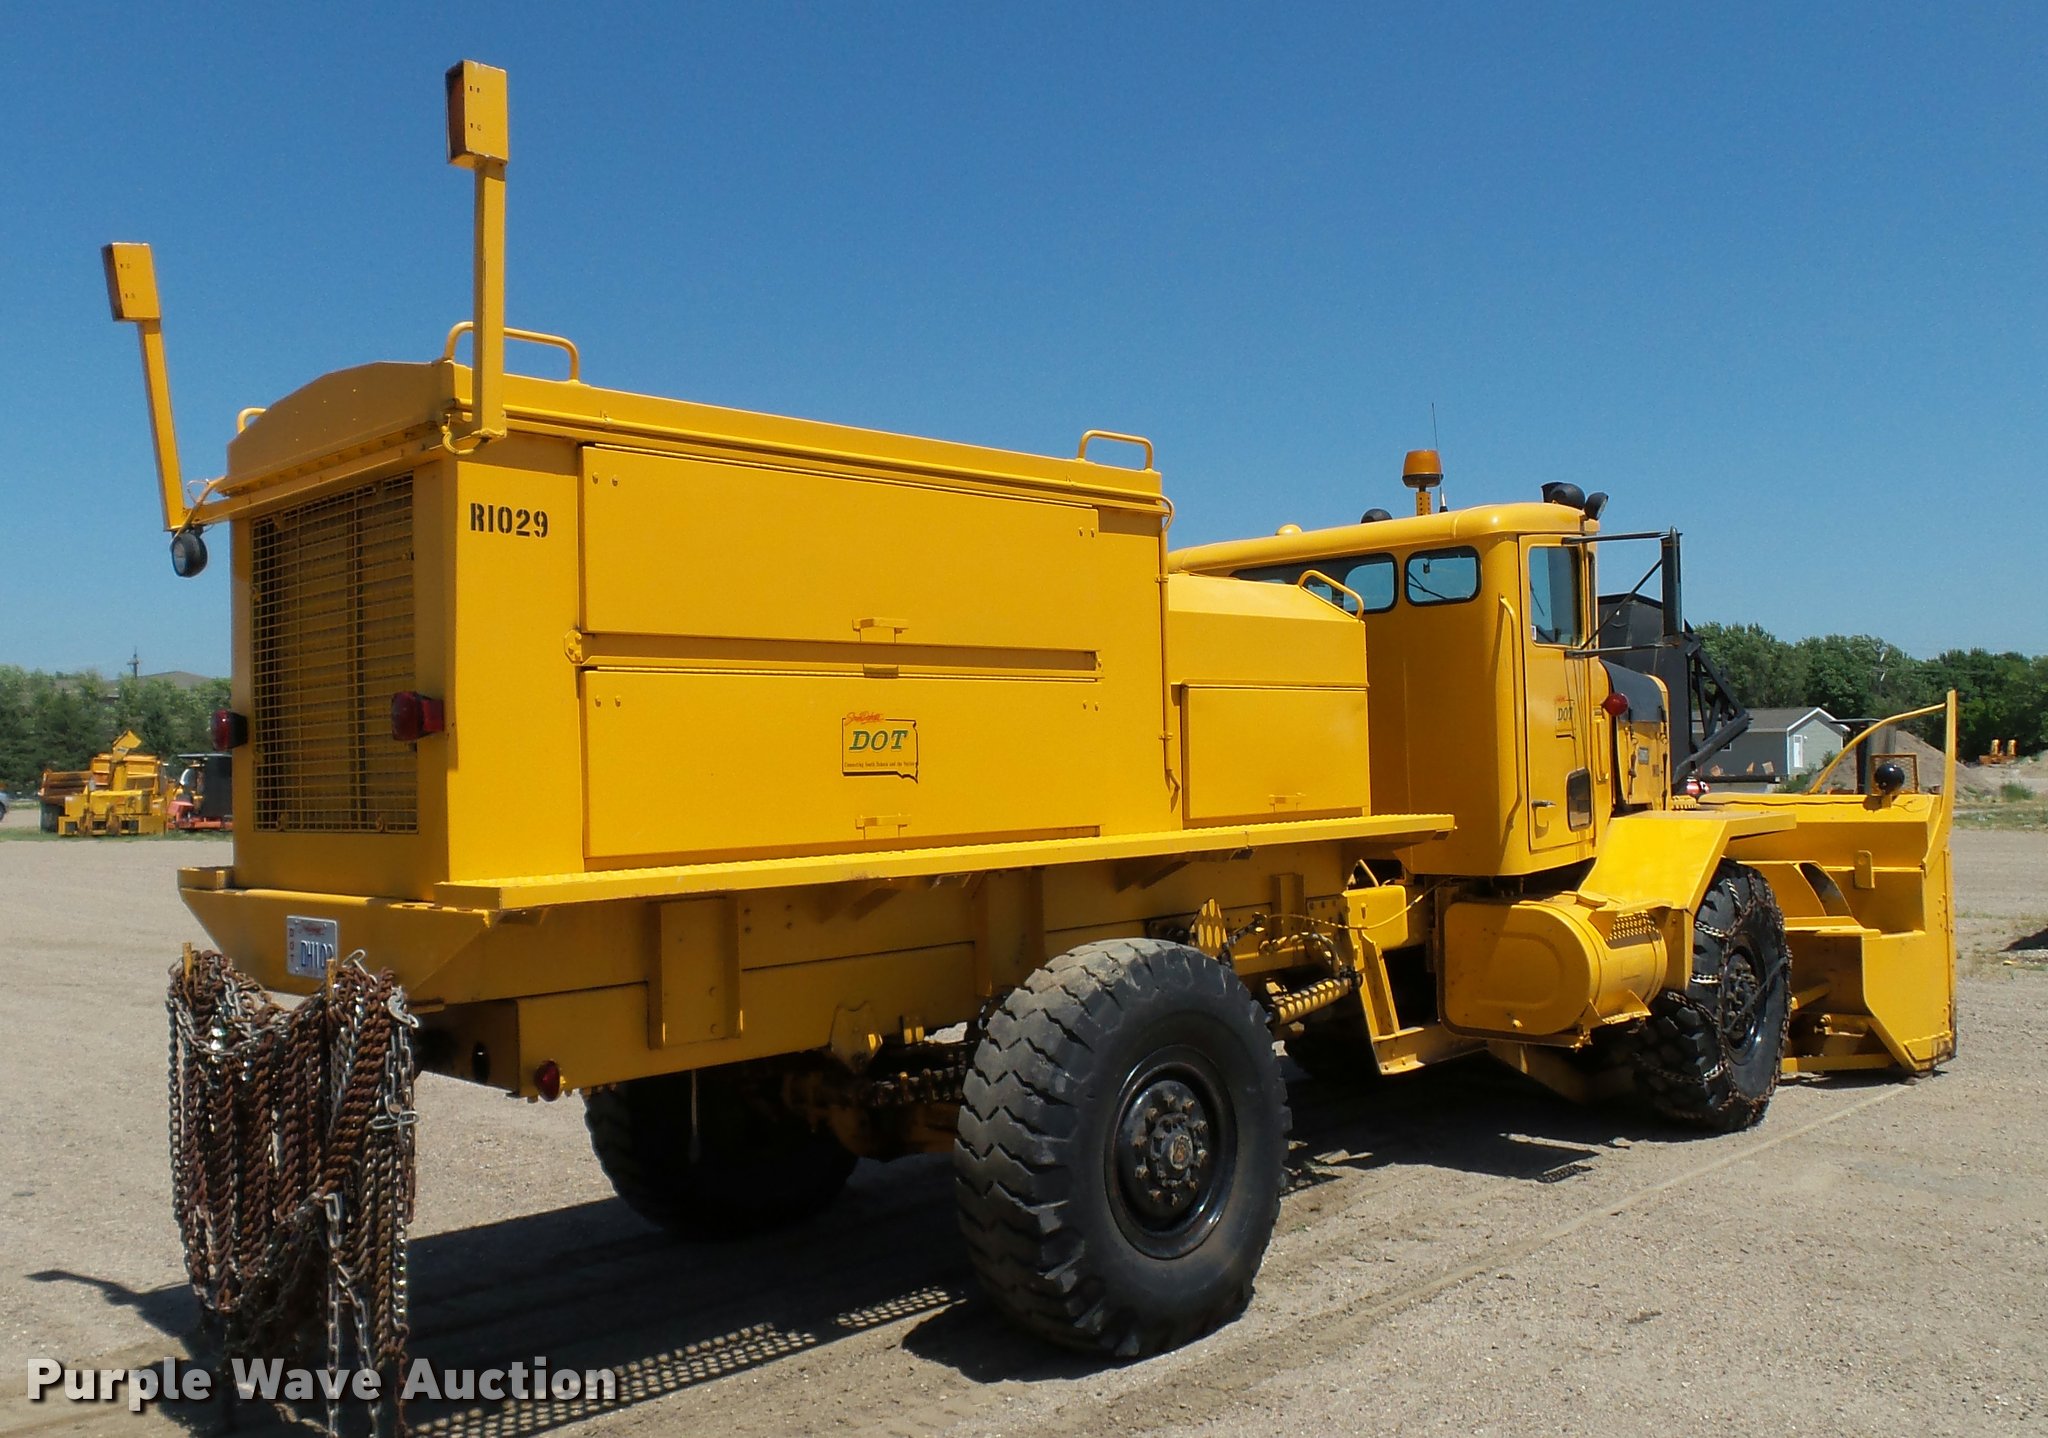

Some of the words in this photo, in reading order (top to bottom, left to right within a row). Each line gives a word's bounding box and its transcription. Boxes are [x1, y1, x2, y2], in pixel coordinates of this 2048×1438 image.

[470, 502, 548, 538] R1029
[1557, 707, 1573, 721] DOT
[849, 730, 908, 750] DOT
